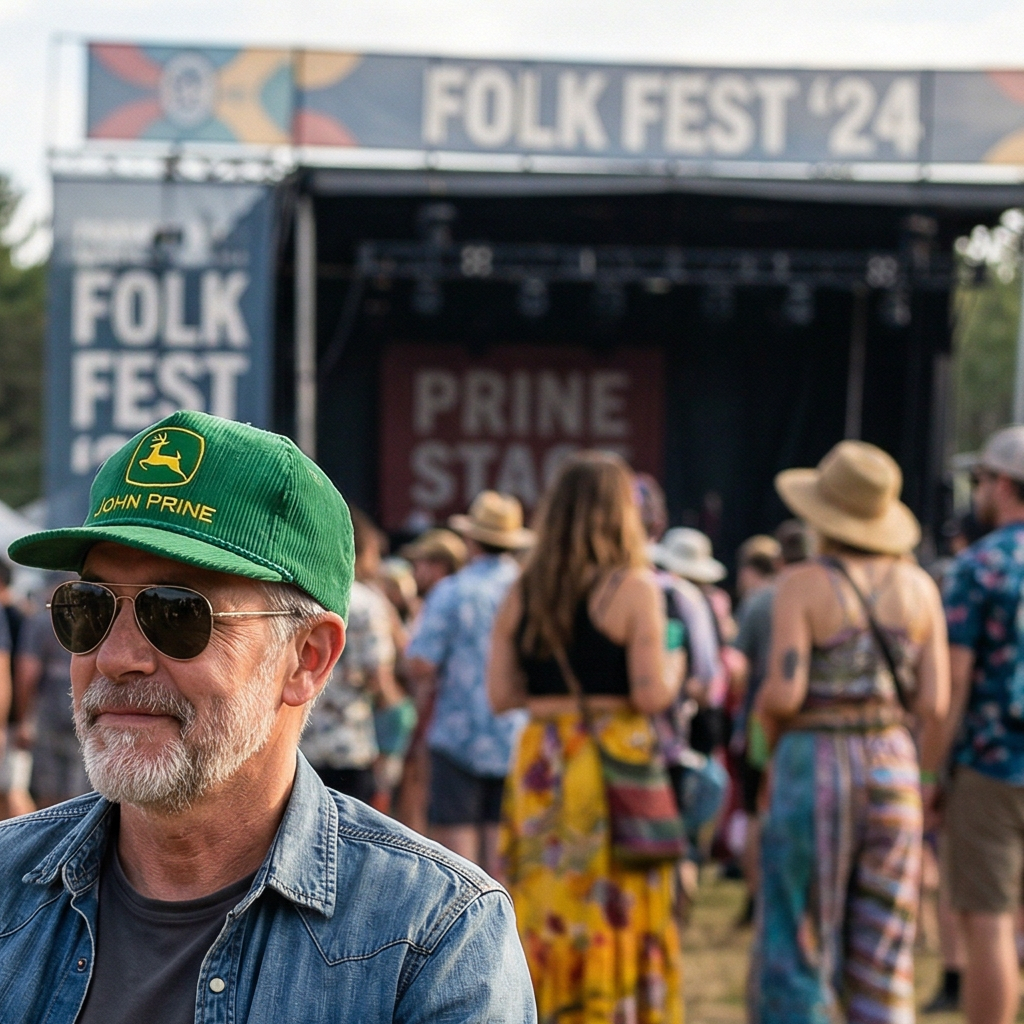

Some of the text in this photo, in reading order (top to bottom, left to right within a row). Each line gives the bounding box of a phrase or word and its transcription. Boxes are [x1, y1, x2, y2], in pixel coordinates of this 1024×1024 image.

[422, 66, 924, 158] FOLK FEST ‘24
[71, 270, 251, 347] FOLK
[71, 352, 251, 429] FEST
[413, 368, 631, 437] PRINE
[93, 493, 217, 524] JOHN PRINE
[410, 441, 632, 507] STA
